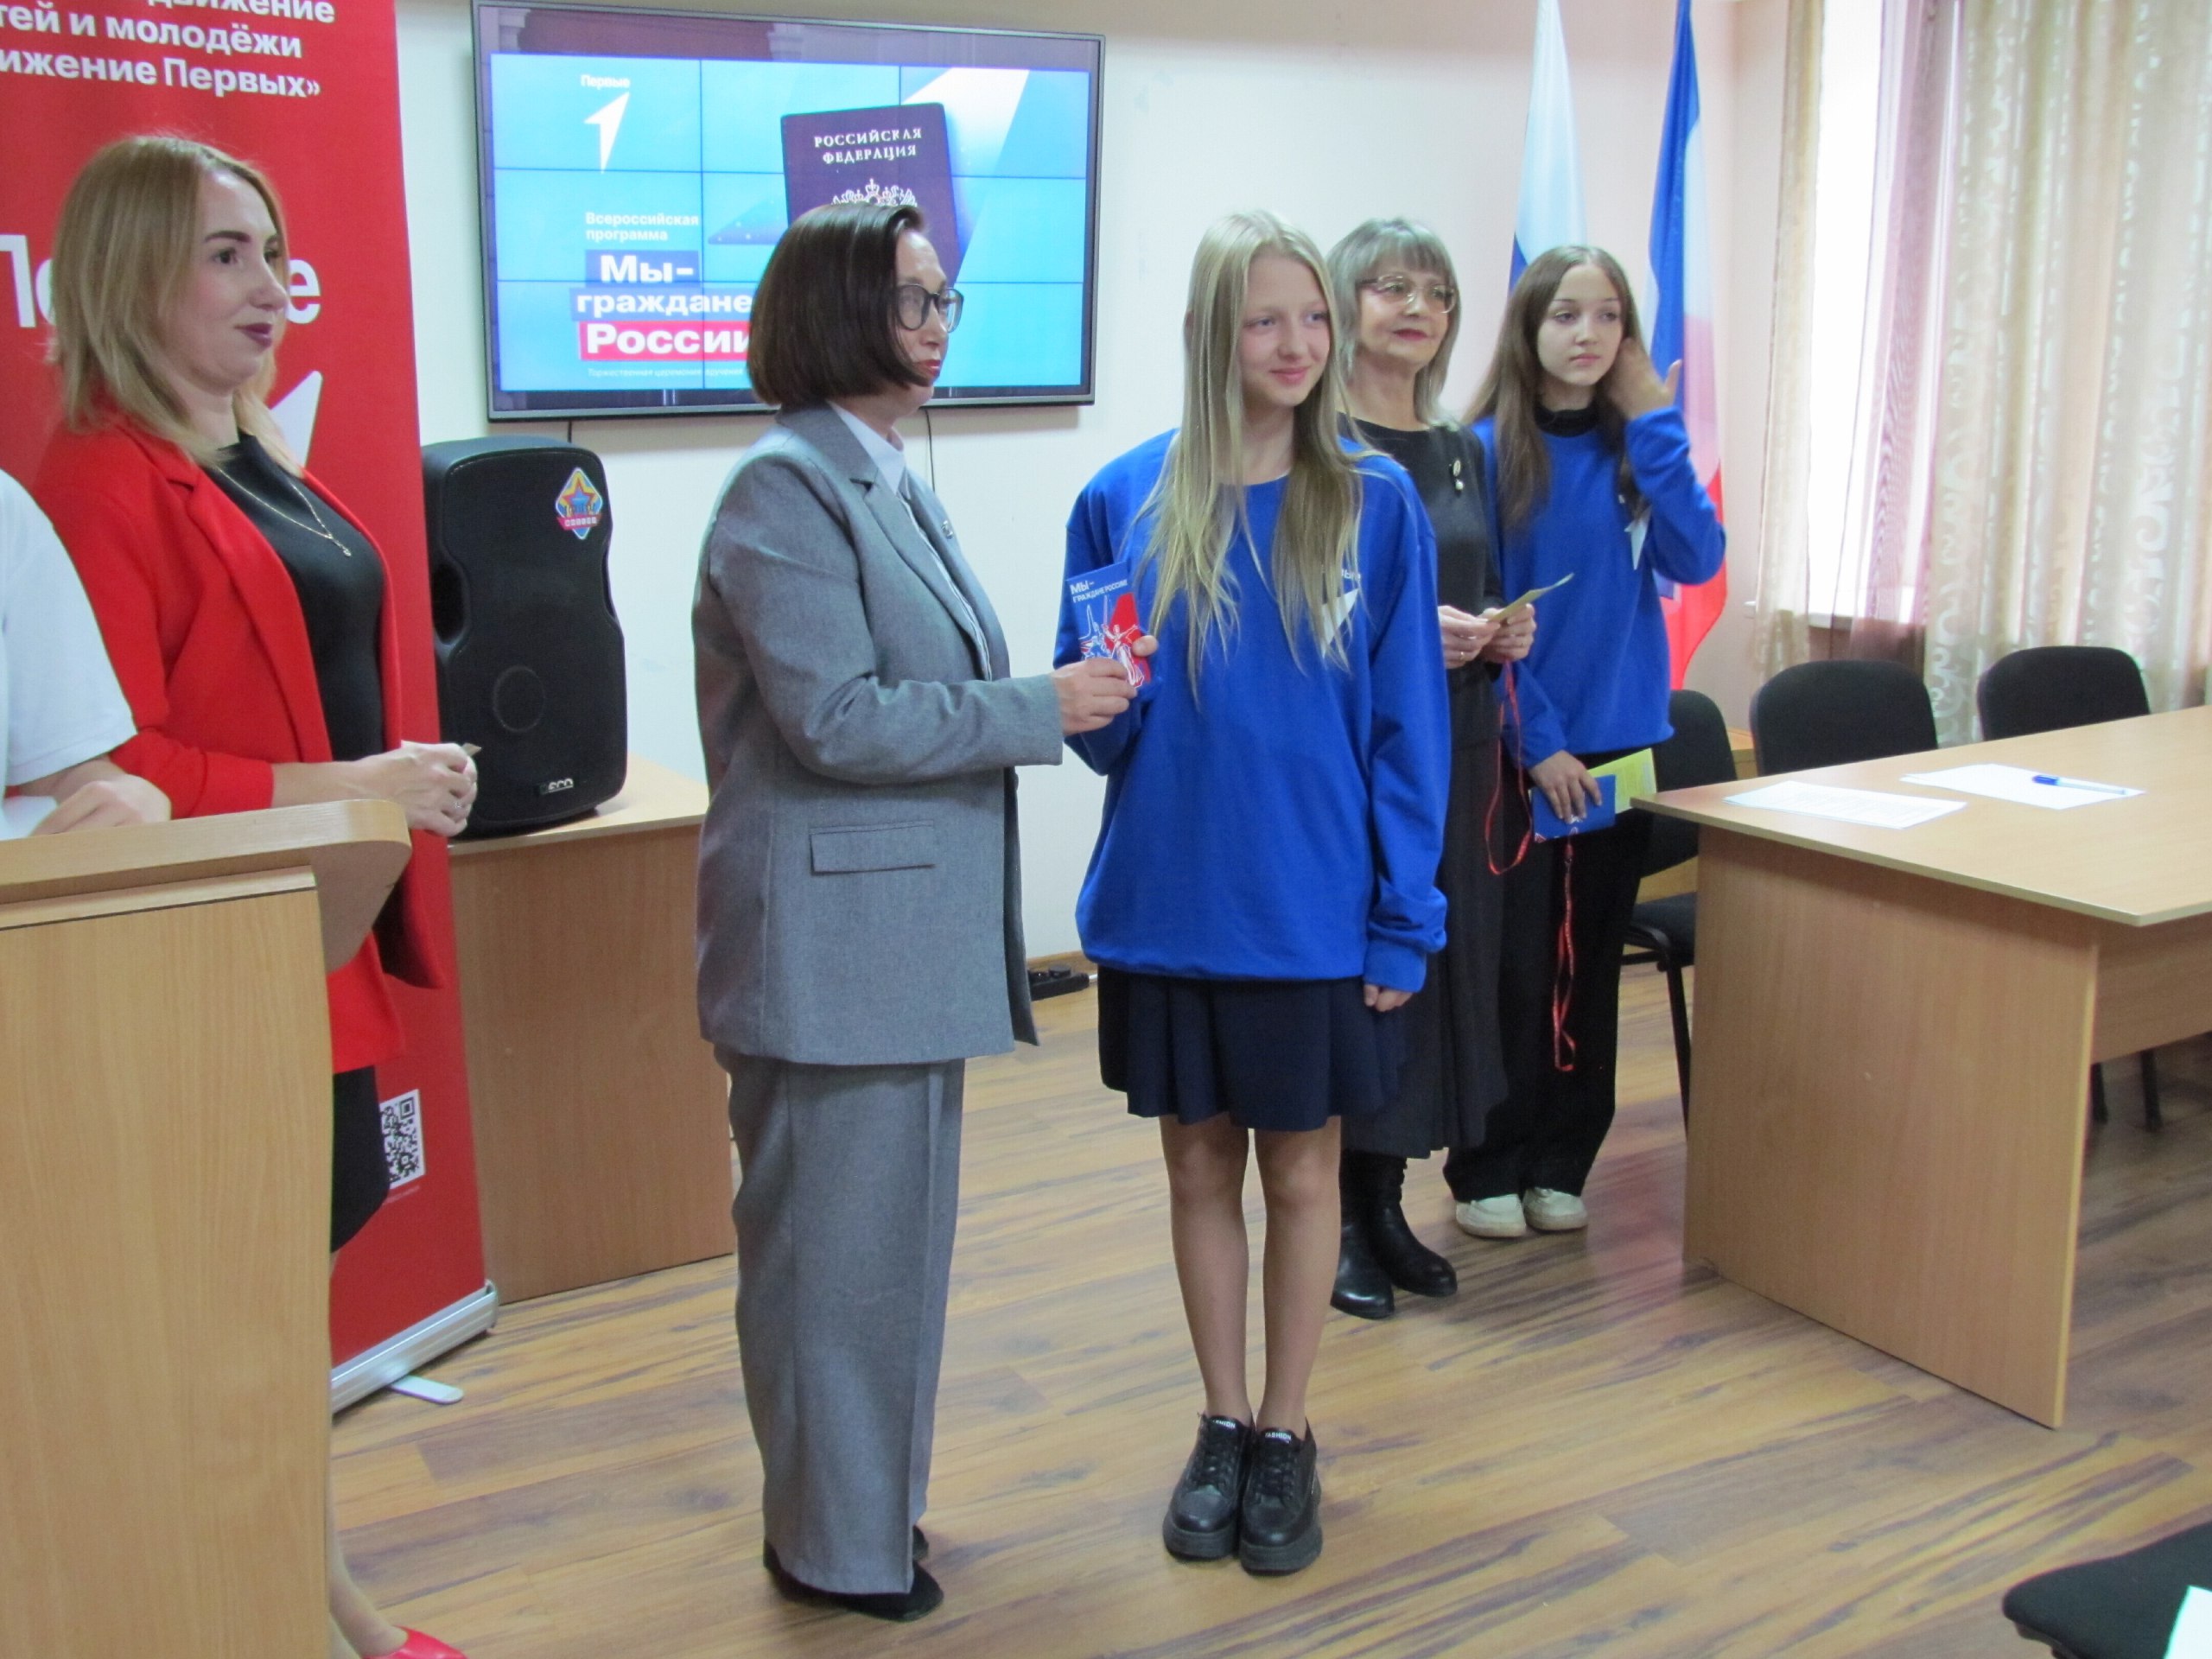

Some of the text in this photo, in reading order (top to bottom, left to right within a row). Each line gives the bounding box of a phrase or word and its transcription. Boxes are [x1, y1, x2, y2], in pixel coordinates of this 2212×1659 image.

[148, 0, 335, 23] жение
[69, 12, 97, 36] и
[105, 16, 302, 58] молодёжи
[0, 48, 321, 98] ижение Первых»
[581, 74, 630, 90] Первые
[814, 128, 922, 148] РОССИЙСКАЯ
[823, 144, 916, 164] ФЕДЕРАЦИЯ
[585, 213, 699, 226] Всероссийская
[586, 229, 668, 243] программа
[601, 255, 694, 283] Мы-
[577, 295, 753, 318] граждане
[1265, 1432, 1292, 1441] FASHION
